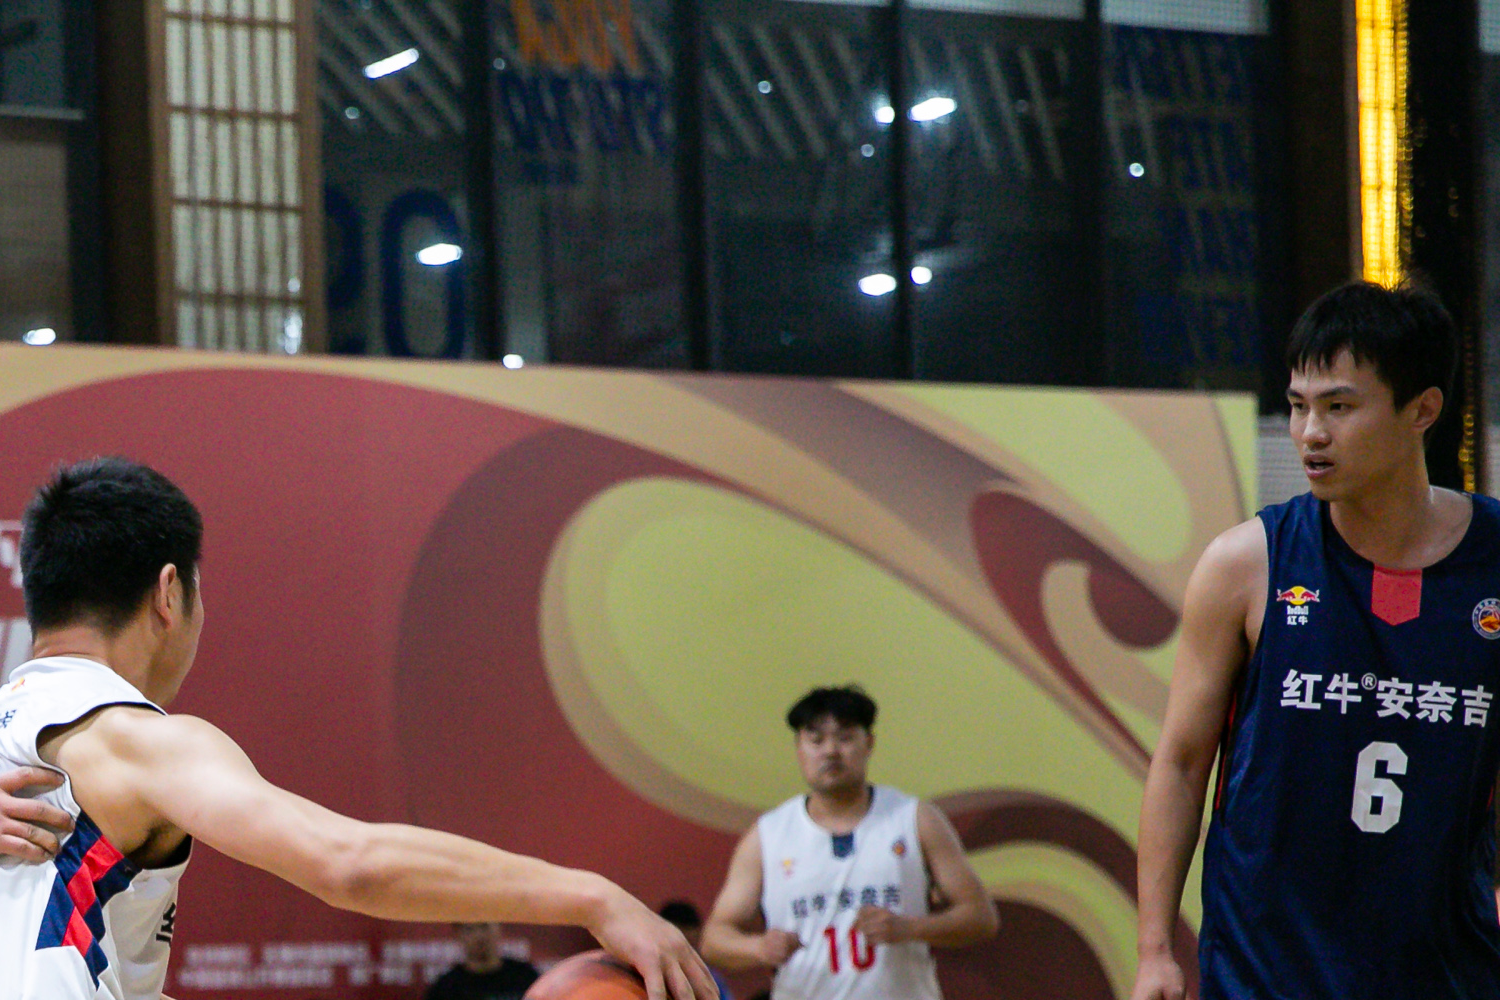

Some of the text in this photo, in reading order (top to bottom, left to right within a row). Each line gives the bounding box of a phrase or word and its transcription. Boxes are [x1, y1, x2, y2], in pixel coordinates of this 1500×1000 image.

[1286, 616, 1309, 625] 红牛
[1351, 741, 1408, 834] 6
[823, 925, 876, 975] 10
